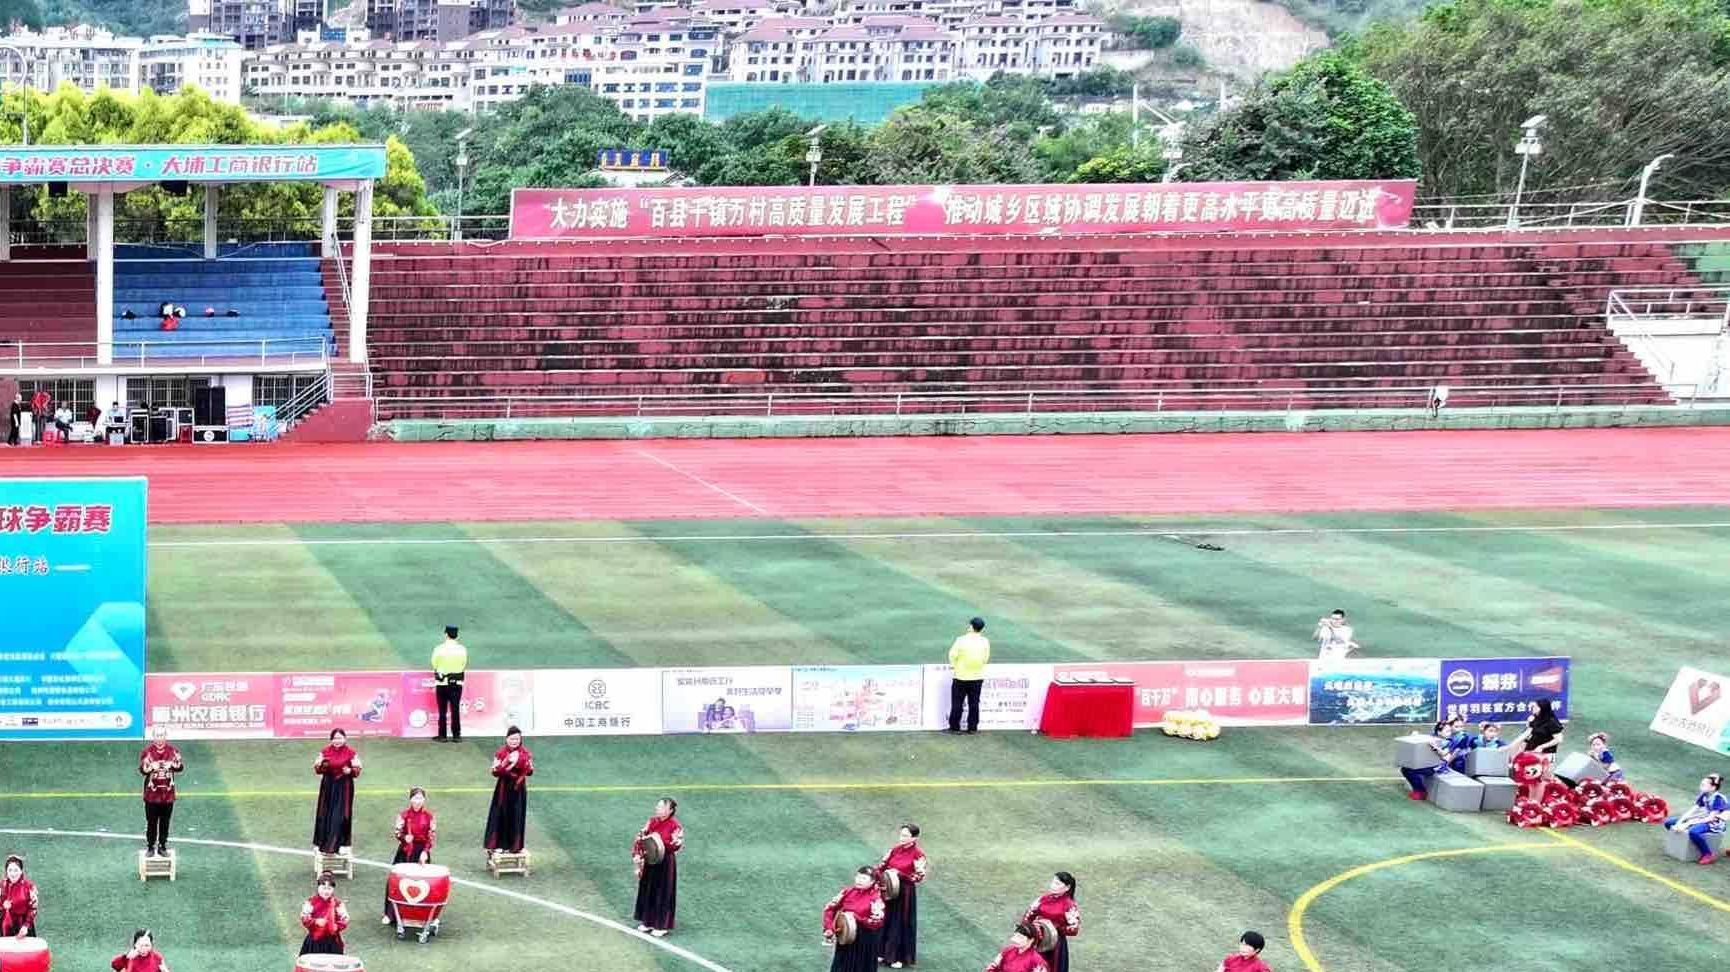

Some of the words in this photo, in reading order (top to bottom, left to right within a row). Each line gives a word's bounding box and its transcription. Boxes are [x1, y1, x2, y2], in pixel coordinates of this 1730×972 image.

[1447, 700, 1562, 714] 世界羽联官方合作伴
